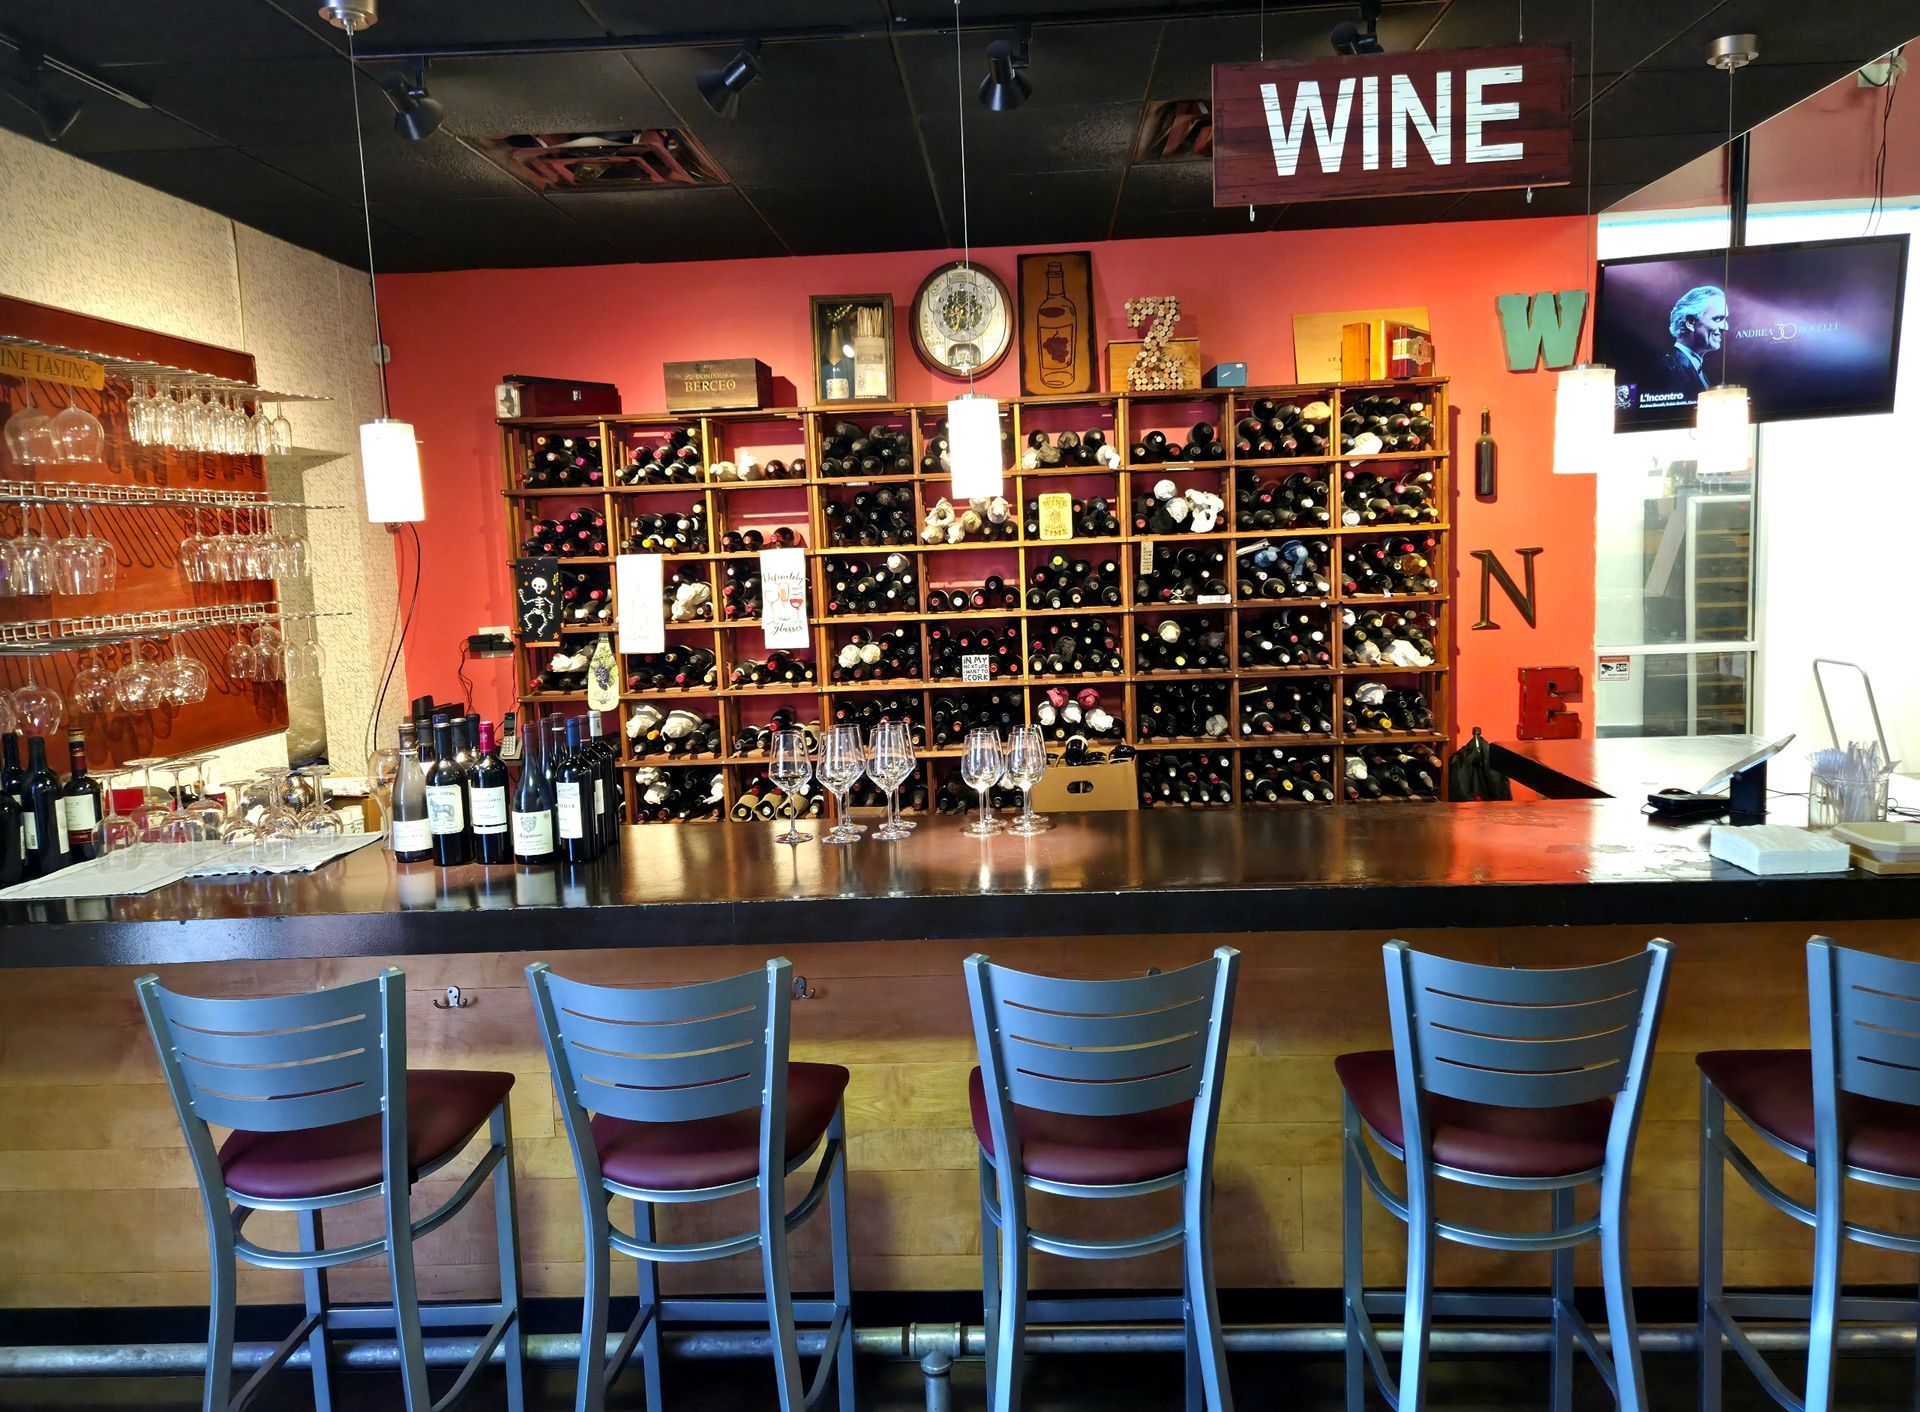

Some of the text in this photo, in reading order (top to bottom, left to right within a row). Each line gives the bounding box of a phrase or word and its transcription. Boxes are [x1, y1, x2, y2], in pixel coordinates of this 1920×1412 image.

[1260, 65, 1523, 176] WINE
[1495, 289, 1587, 372] W
[1735, 328, 1773, 339] ANDREA
[1771, 321, 1797, 340] 30
[33, 354, 90, 381] TASTING
[684, 379, 736, 392] BERCEO
[1640, 392, 1684, 402] L'Incontro
[1043, 500, 1068, 508] WINE
[1043, 528, 1068, 537] TIME
[1470, 547, 1543, 630] N
[773, 622, 803, 635] glasses
[974, 656, 987, 664] MY
[1516, 667, 1583, 741] E
